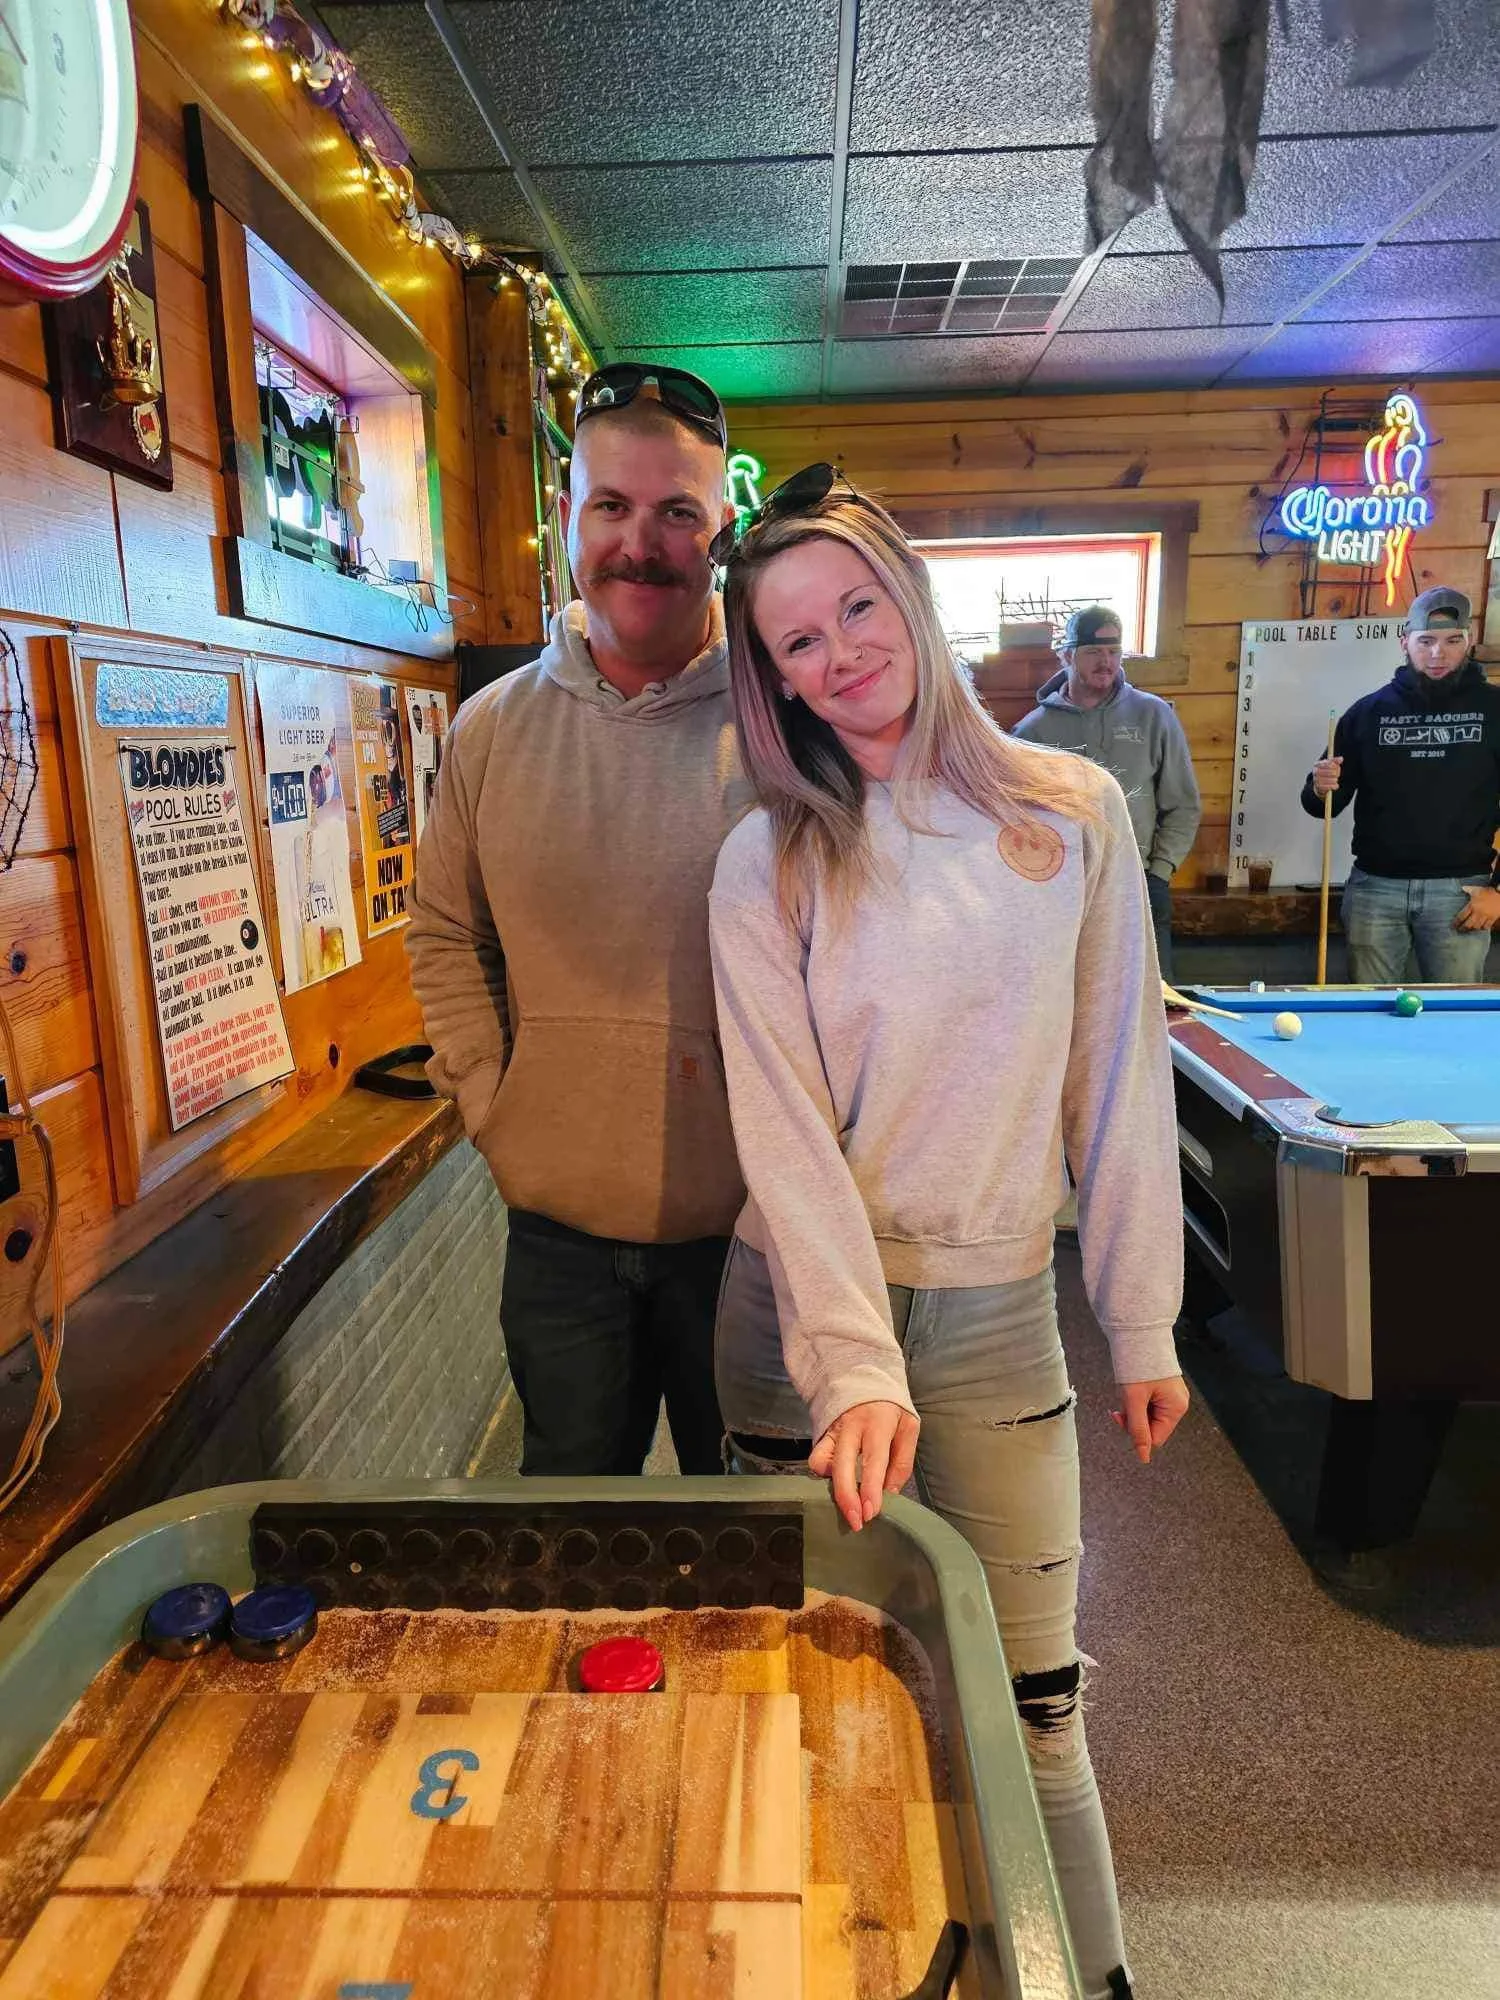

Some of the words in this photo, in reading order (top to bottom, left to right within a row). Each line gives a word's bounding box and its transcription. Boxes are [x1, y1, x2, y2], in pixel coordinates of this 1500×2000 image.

[1281, 486, 1428, 536] Corona
[1318, 529, 1385, 562] LIGHT
[1255, 627, 1287, 642] POOL
[1297, 625, 1337, 641] TABLE
[1356, 624, 1388, 640] SIGN
[1248, 651, 1254, 666] 1
[1245, 675, 1253, 689] 2
[280, 704, 320, 721] SUPERIOR
[1244, 698, 1250, 712] 3
[279, 728, 303, 745] LIGHT
[306, 728, 325, 745] BEER
[1242, 722, 1249, 736] 4
[1241, 744, 1248, 758] 5
[1240, 768, 1247, 782] 6
[271, 783, 306, 818] $4.00
[1238, 790, 1246, 804] 7
[146, 798, 180, 821] POOL
[184, 793, 222, 816] RULES
[1238, 812, 1244, 826] 8
[1236, 834, 1242, 848] 9
[377, 853, 403, 887] NOW
[1236, 856, 1248, 870] 10
[304, 896, 335, 922] ULTRA
[373, 891, 389, 923] ON
[391, 885, 408, 915] TA
[410, 1749, 480, 1819] 3
